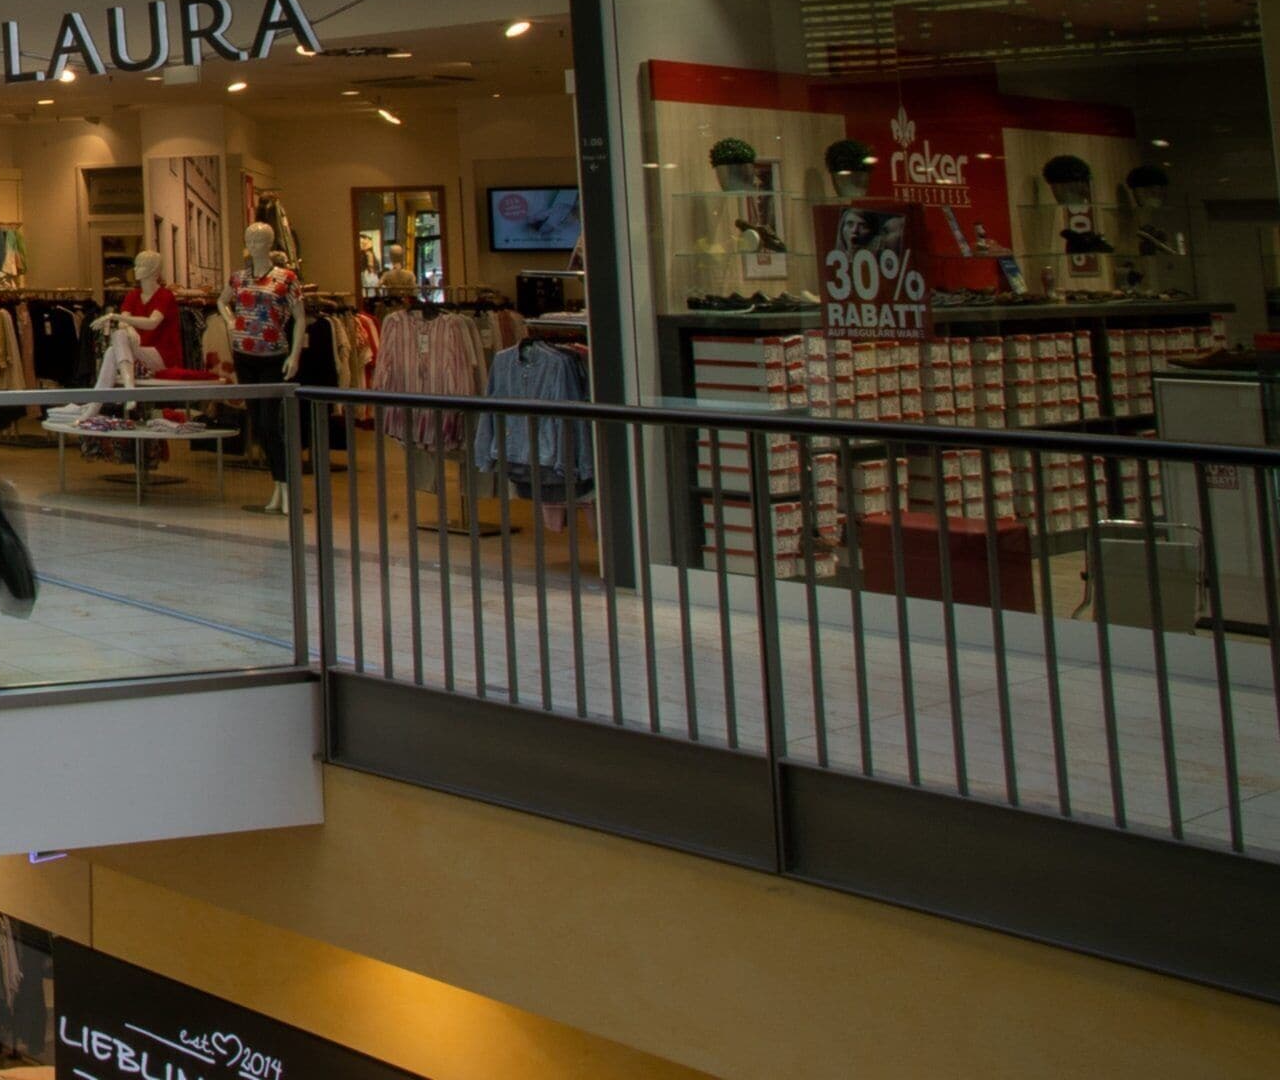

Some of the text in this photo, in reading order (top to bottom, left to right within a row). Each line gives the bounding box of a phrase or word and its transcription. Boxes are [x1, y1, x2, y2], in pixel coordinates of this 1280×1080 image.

[890, 139, 968, 185] rieker
[825, 248, 925, 301] 30%
[827, 302, 927, 329] RABATT
[828, 328, 846, 337] AUF
[897, 328, 926, 338] WARE
[239, 1047, 283, 1080] 2014
